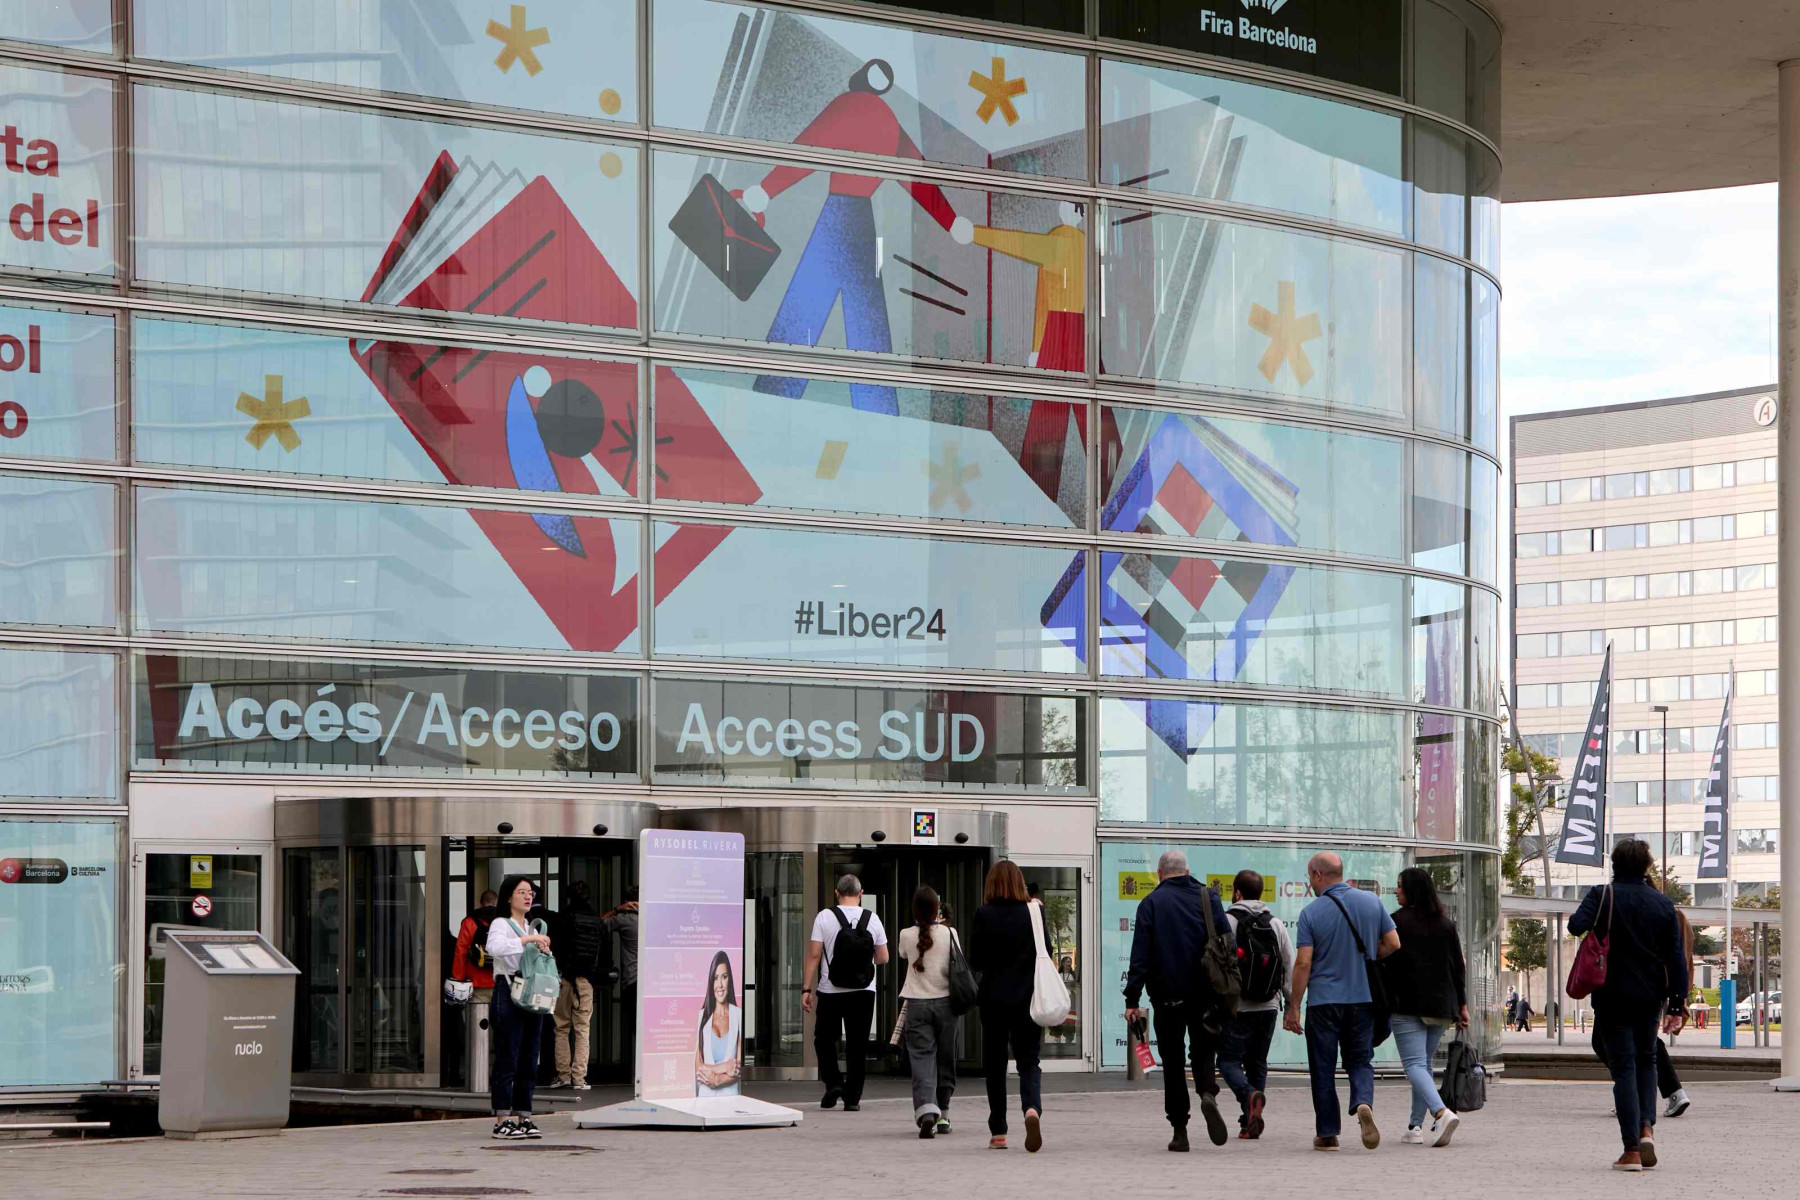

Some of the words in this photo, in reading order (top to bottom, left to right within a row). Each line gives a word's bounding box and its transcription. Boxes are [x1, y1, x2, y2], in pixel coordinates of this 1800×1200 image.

[1200, 9, 1234, 36] Fira
[1238, 16, 1317, 54] Barcelona
[0, 125, 59, 178] ta
[9, 192, 99, 248] del
[0, 324, 41, 374] ol
[794, 600, 947, 641] #Liber24
[675, 702, 862, 760] Access
[877, 710, 986, 763] SUD
[25, 869, 60, 877] Barcelona
